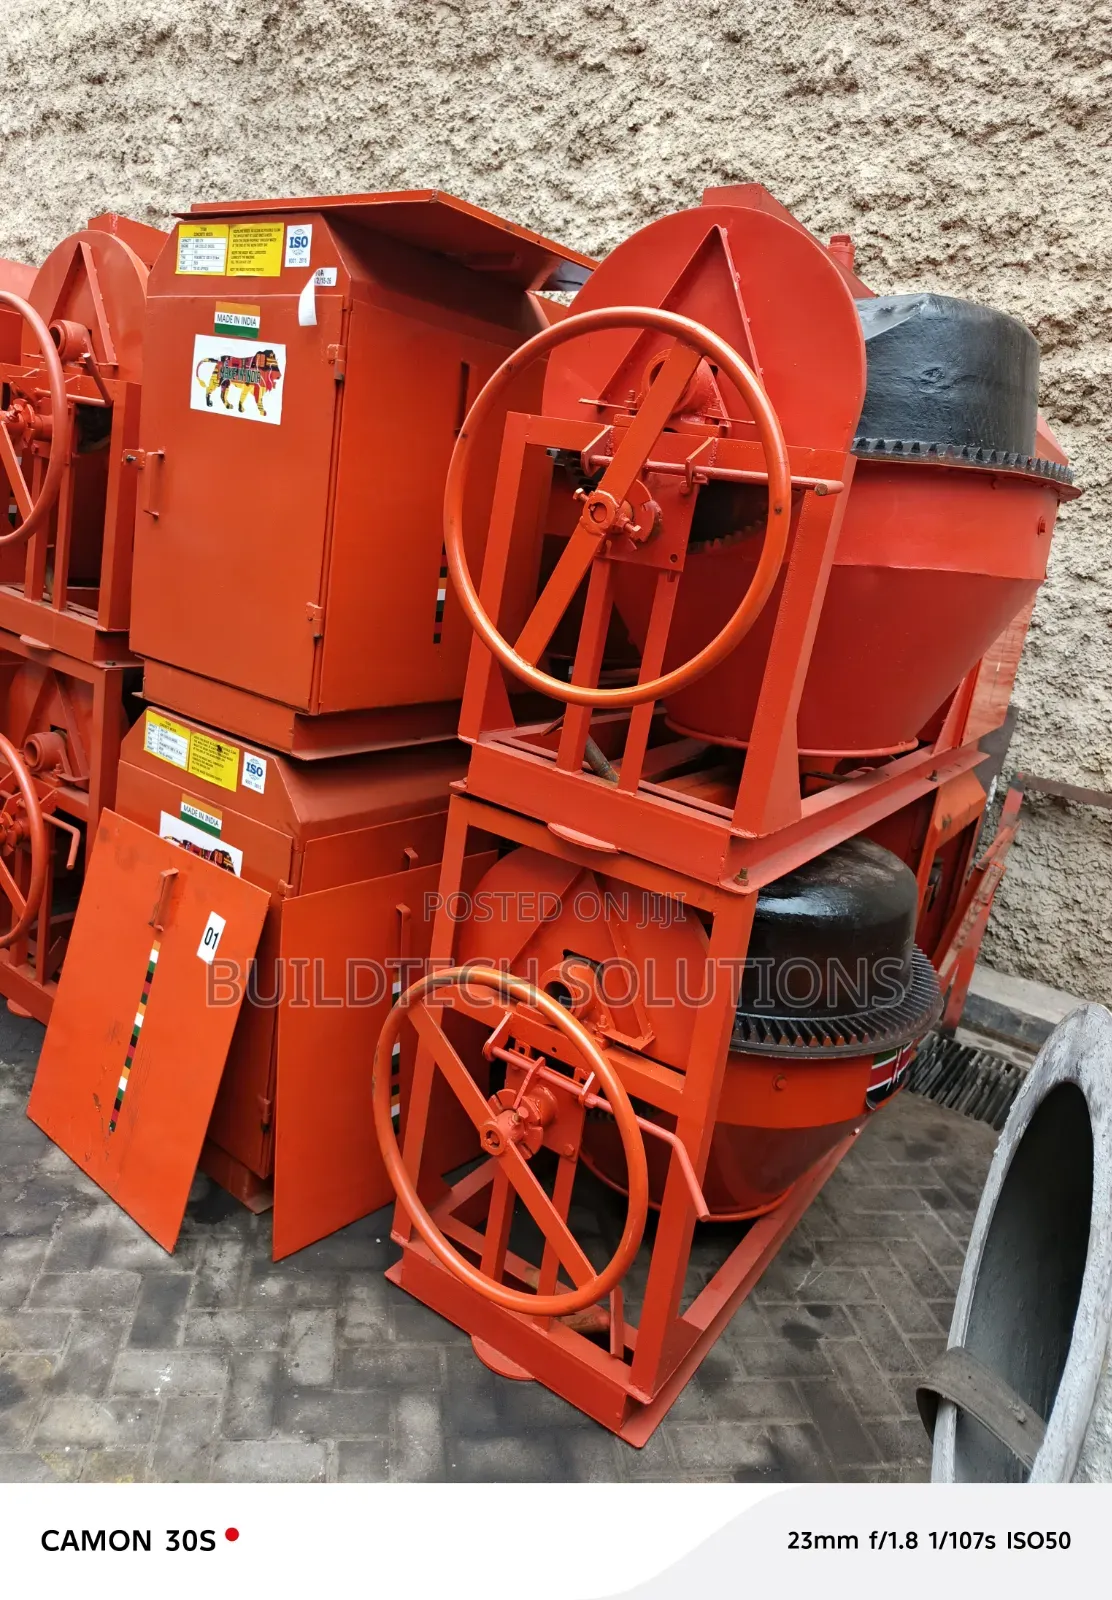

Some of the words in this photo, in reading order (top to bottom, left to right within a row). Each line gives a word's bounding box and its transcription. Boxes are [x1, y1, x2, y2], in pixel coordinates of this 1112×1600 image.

[289, 236, 308, 248] ISO
[216, 313, 233, 324] MADE
[234, 315, 240, 325] IN
[241, 316, 257, 327] INDIA
[221, 366, 237, 380] MAKE
[245, 369, 261, 383] INDIA
[246, 761, 263, 777] ISO
[183, 804, 198, 817] MADE
[198, 811, 204, 820] IN
[205, 815, 219, 826] INDIA
[204, 926, 219, 950] 01
